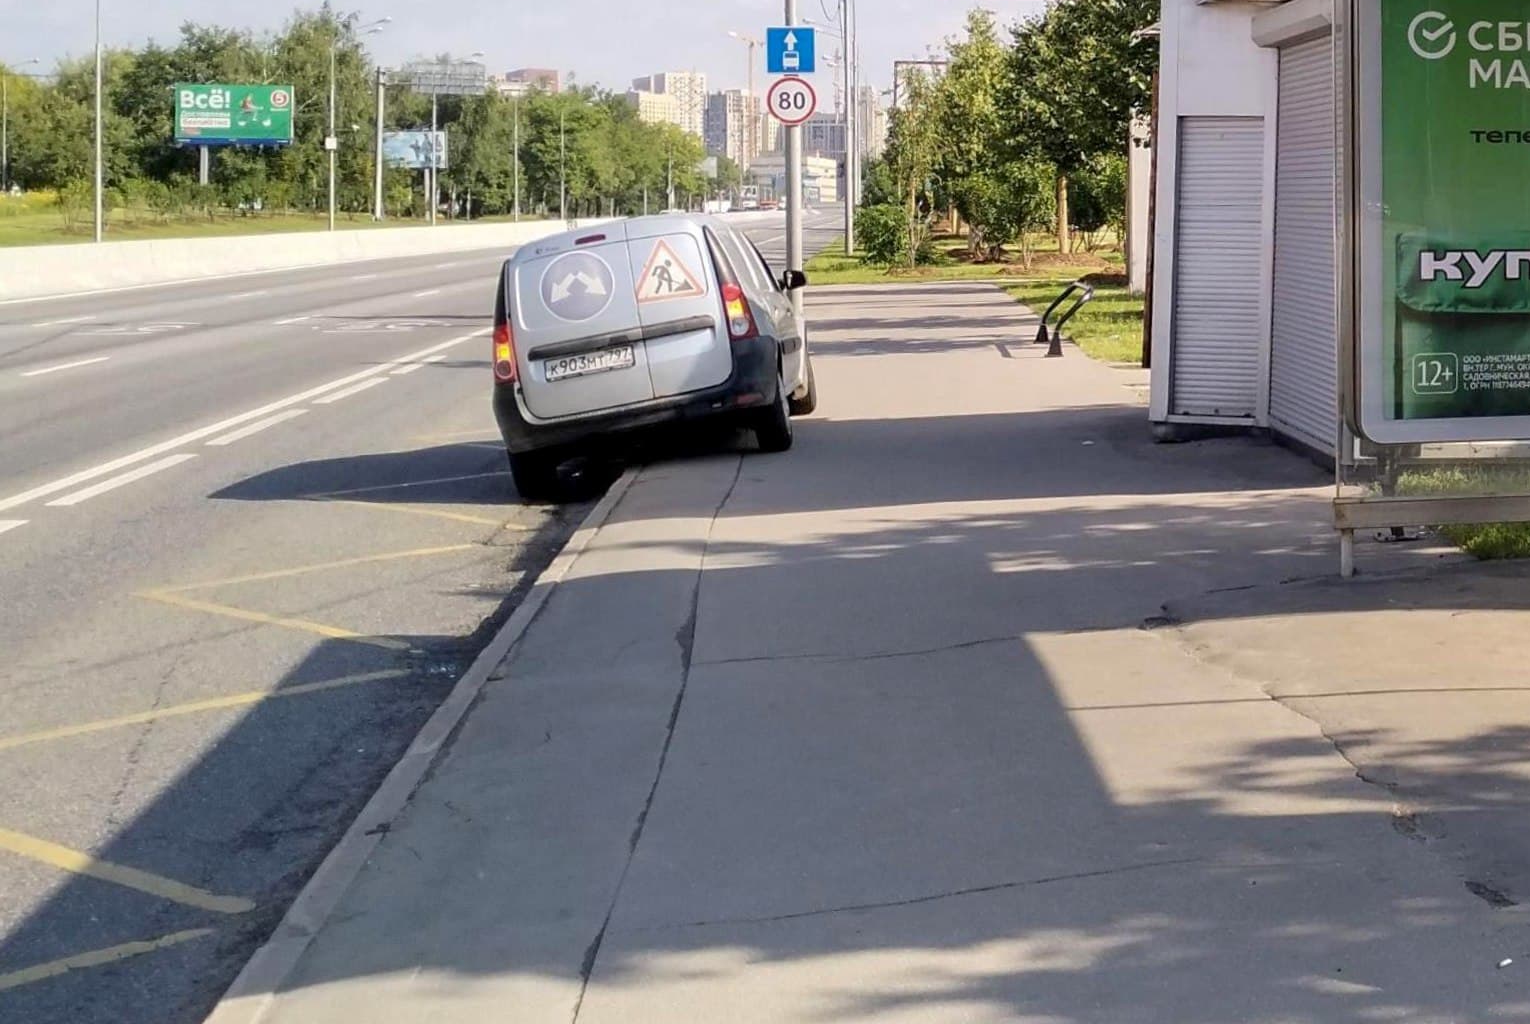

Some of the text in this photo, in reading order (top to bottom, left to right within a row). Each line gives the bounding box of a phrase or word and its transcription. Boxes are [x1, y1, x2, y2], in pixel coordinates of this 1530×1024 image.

[180, 89, 231, 109] Всё!
[778, 91, 806, 110] 80
[1463, 355, 1481, 364] ООО
[1417, 360, 1454, 386] 12+
